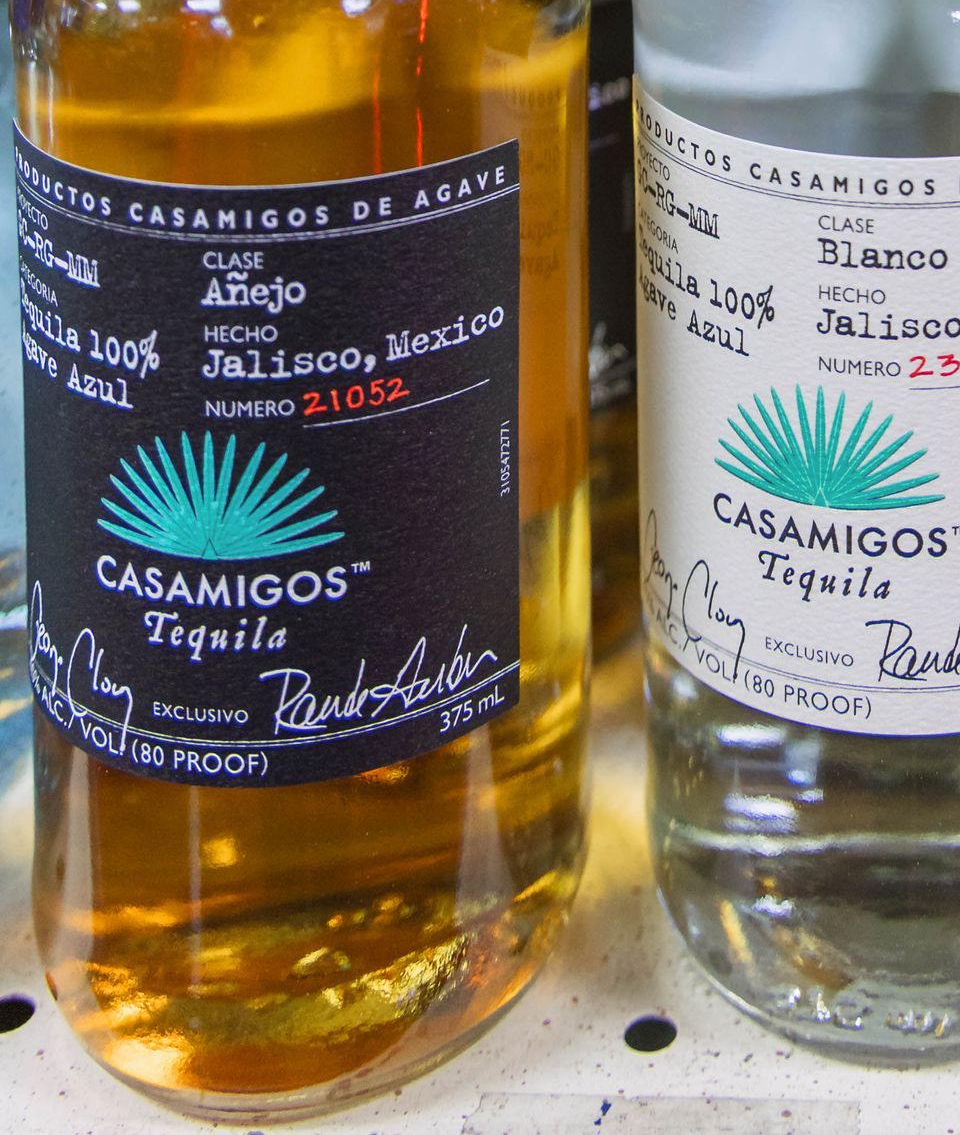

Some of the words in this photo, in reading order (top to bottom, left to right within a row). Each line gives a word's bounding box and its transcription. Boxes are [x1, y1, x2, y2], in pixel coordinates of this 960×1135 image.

[128, 202, 331, 230] CASAMIGOS
[352, 196, 393, 221] DE
[413, 165, 506, 210] AGAVE
[749, 162, 936, 197] CASAMIGOS
[638, 202, 679, 255] ATEGORIA
[817, 215, 875, 235] CLASE
[202, 251, 265, 270] CLASE
[817, 237, 949, 271] Blanco
[19, 254, 58, 307] TEGORIA
[200, 271, 307, 314] Añejo
[817, 284, 887, 305] HECHO
[709, 278, 775, 330] 100%
[89, 329, 161, 379] 100%
[201, 347, 378, 380] Jalisco,
[385, 305, 505, 362] Mexico
[203, 325, 279, 344] HECHO
[686, 309, 750, 357] Azul
[66, 362, 134, 409] Azul
[817, 356, 902, 378] NUMERO
[204, 399, 296, 418] NUMERO
[303, 377, 411, 416] 21052
[758, 550, 891, 603] Tequila
[144, 610, 288, 662] Tequila
[764, 636, 855, 668] EXCLUSIVO
[152, 701, 249, 725] EXCLUSIVO
[439, 699, 474, 733] 375
[477, 684, 505, 715] mL
[743, 668, 776, 699] (80
[783, 683, 873, 720] PROOF)
[131, 737, 165, 767] (80
[173, 748, 269, 777] PROOF)
